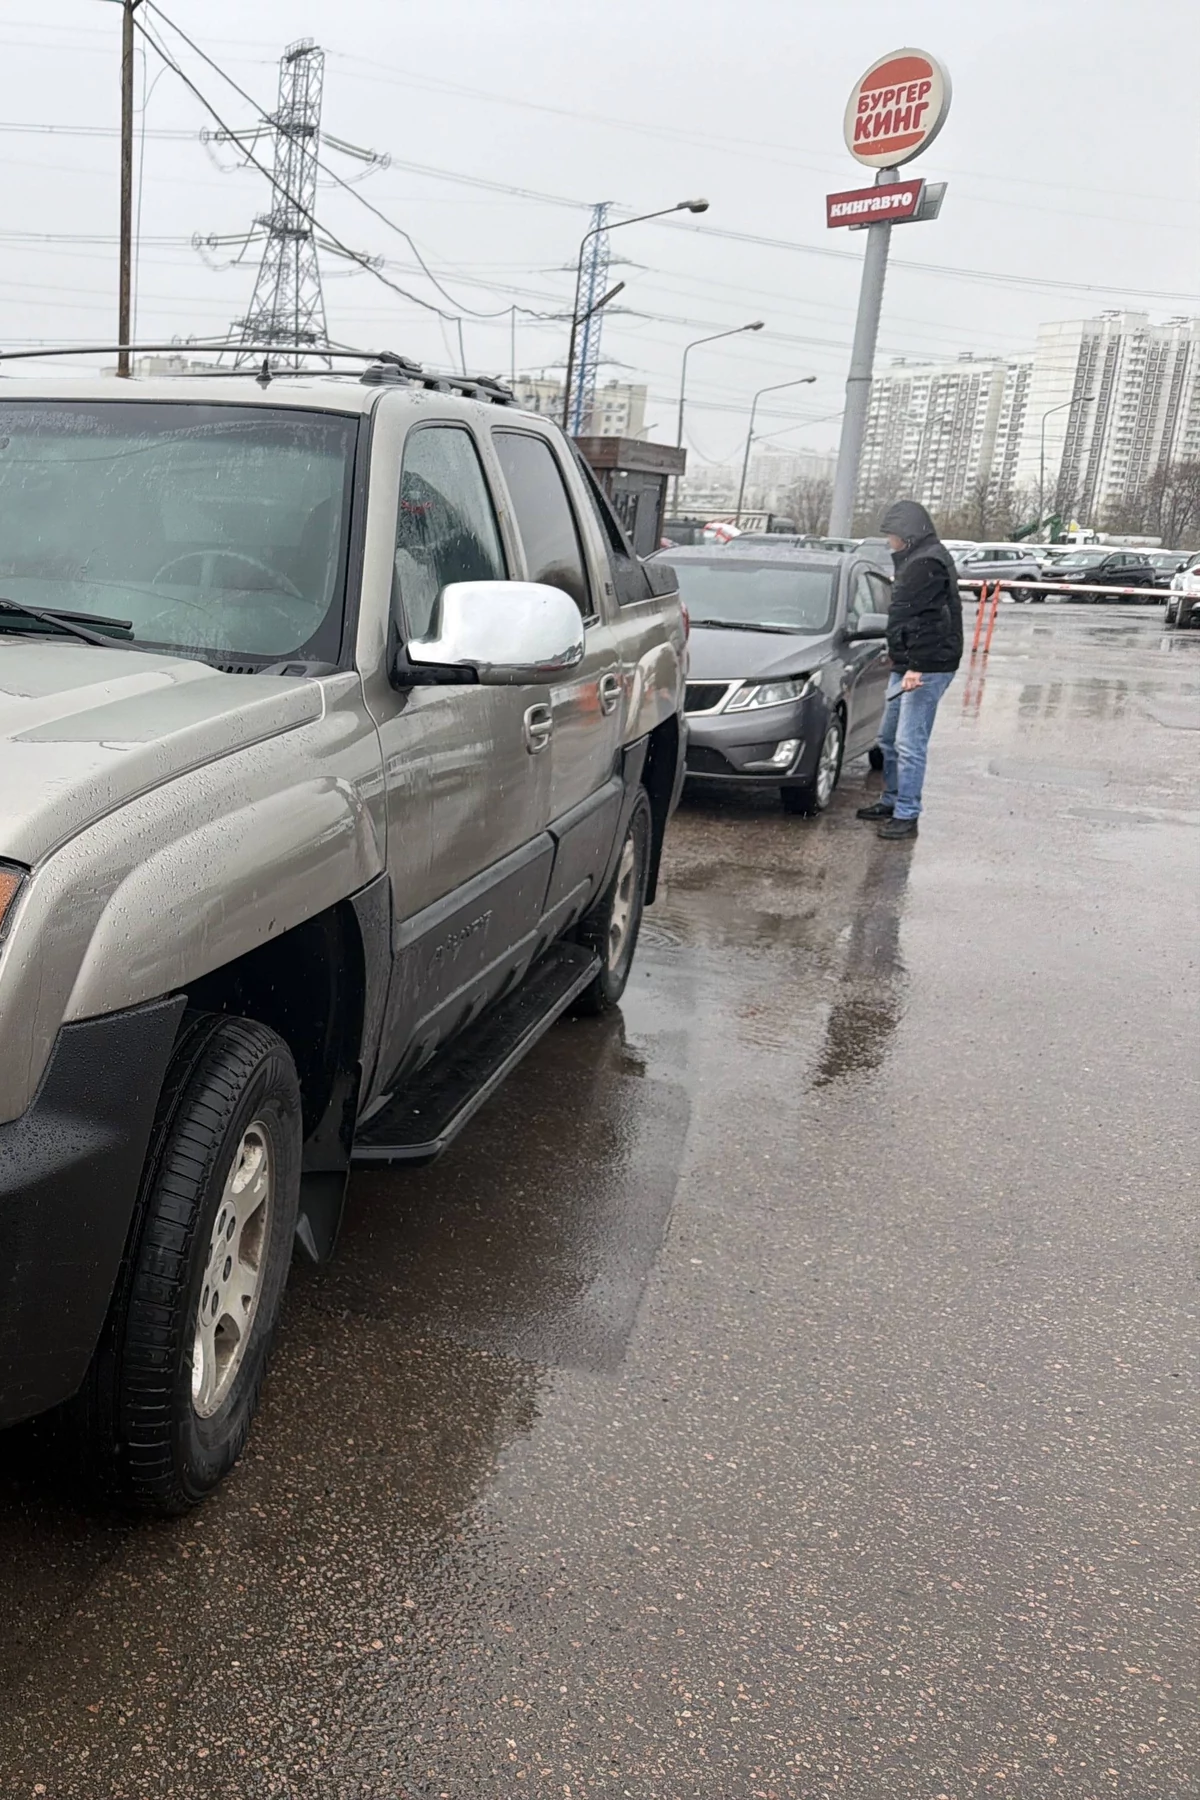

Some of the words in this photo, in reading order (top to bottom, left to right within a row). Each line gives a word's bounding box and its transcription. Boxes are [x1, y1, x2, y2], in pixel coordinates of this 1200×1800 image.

[857, 80, 932, 114] БУРГЕР
[854, 101, 930, 141] КИНГ
[830, 192, 913, 218] кингавто
